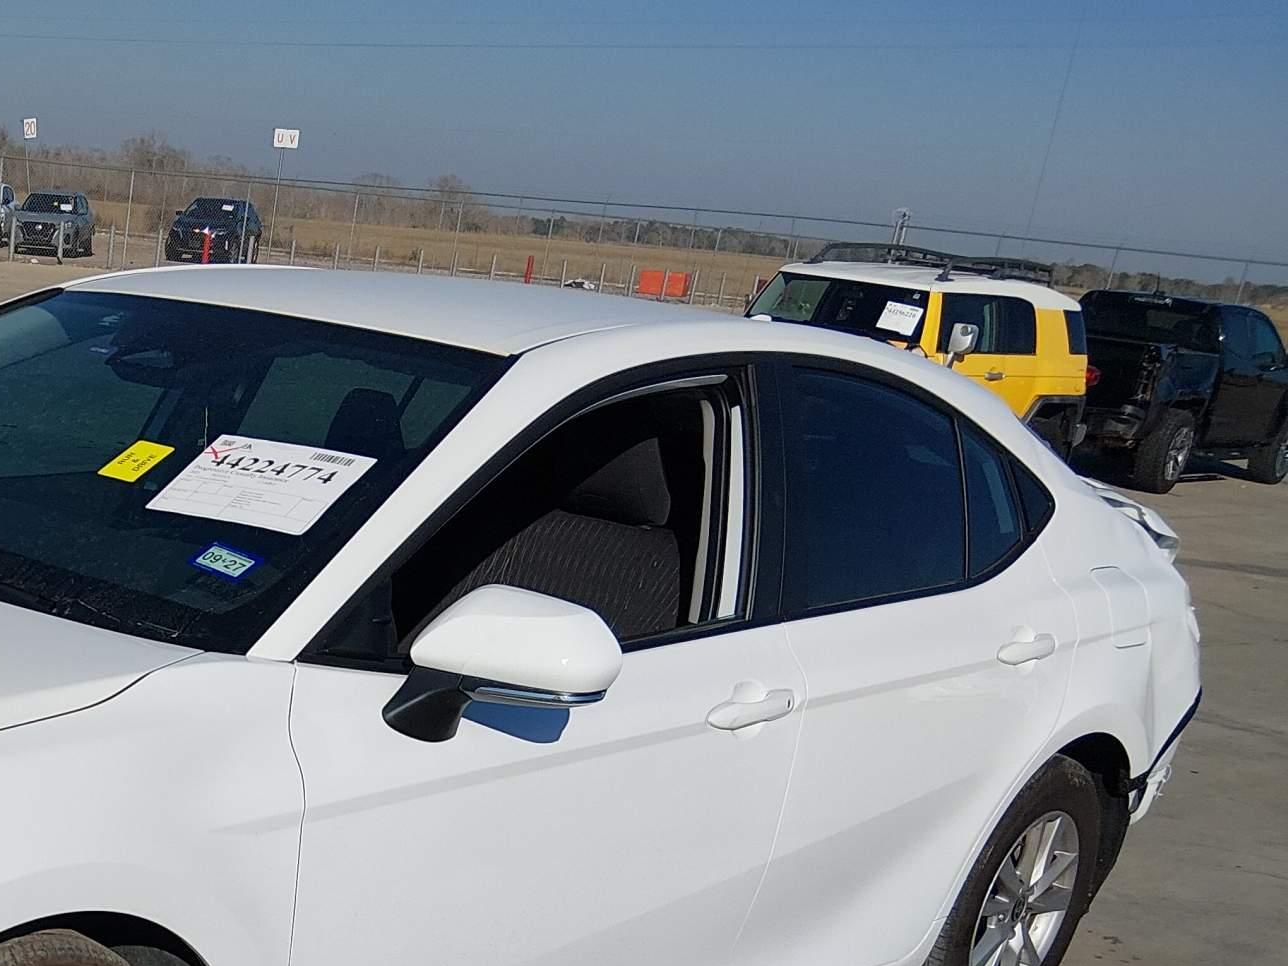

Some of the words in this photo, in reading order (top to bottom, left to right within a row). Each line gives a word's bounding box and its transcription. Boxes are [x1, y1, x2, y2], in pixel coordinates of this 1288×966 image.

[24, 120, 36, 136] 20
[277, 133, 284, 144] U
[289, 134, 297, 145] V
[211, 453, 339, 484] 44224774
